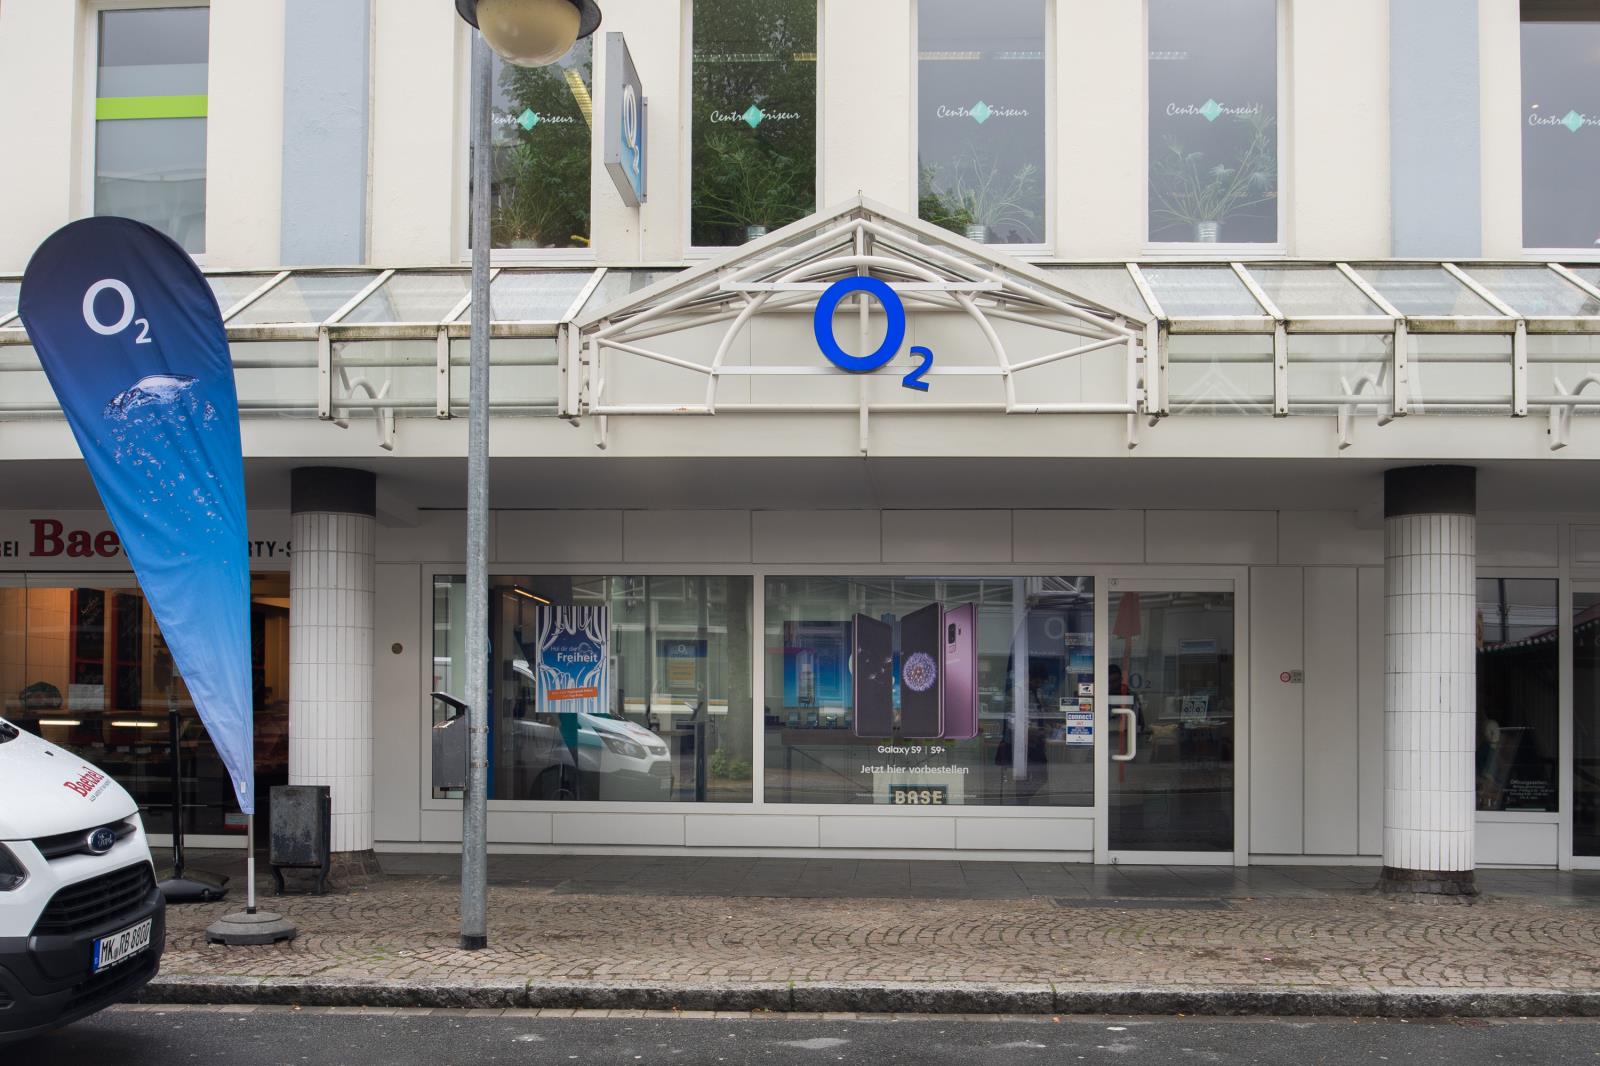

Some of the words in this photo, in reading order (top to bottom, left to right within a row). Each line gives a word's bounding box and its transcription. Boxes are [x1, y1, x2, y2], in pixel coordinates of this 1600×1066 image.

[491, 111, 530, 124] entral
[710, 108, 753, 123] Central
[759, 108, 801, 122] Friseur
[937, 103, 981, 118] Central
[987, 104, 1029, 117] Friseur
[0, 541, 19, 557] EI
[29, 519, 127, 558] Bae
[557, 652, 598, 662] Freiheit
[877, 745, 909, 755] Galaxy
[911, 745, 922, 754] S9
[930, 746, 945, 754] S9+
[860, 764, 884, 774] Jetzt
[887, 764, 906, 774] hier
[909, 764, 969, 774] vorbestellen
[895, 790, 943, 804] BASE
[101, 938, 115, 963] MK
[119, 932, 131, 955] RB
